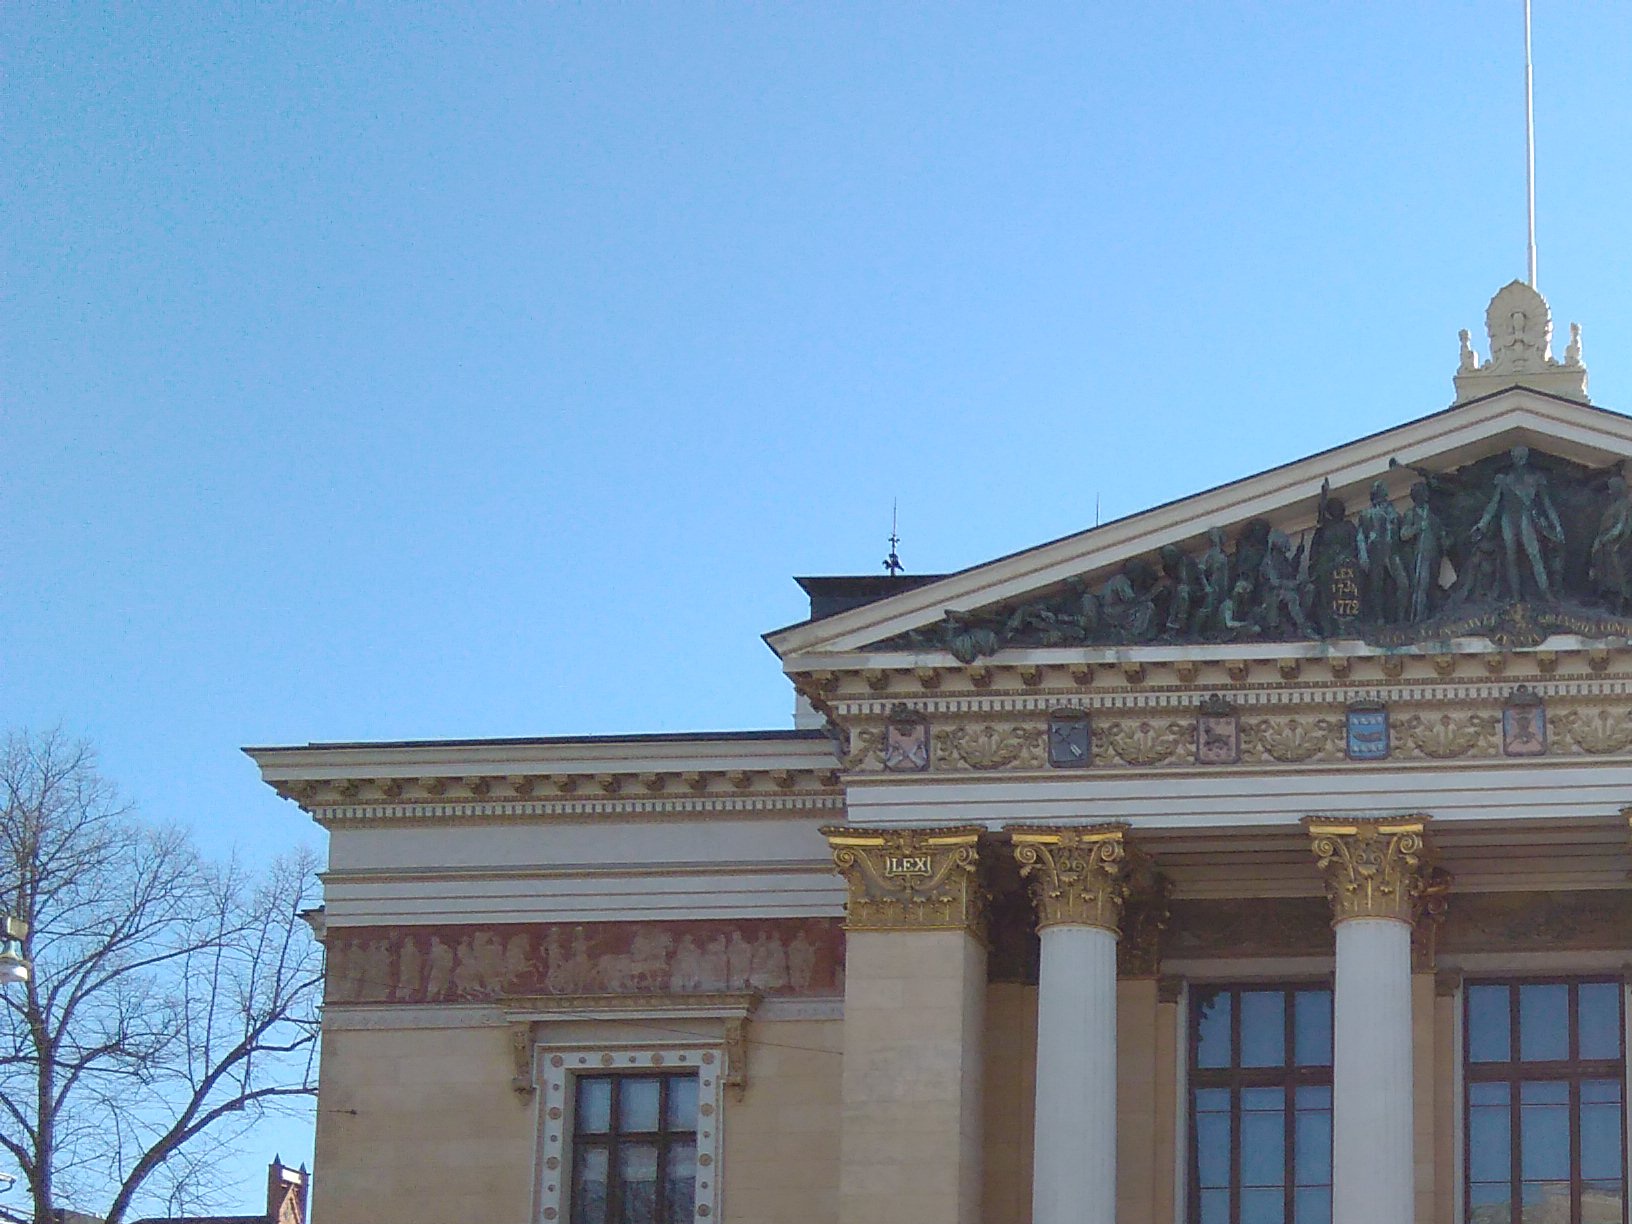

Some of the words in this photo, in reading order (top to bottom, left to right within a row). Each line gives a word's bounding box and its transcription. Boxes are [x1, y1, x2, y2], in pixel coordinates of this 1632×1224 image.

[1332, 568, 1355, 579] LEX
[1332, 600, 1360, 615] 1772
[890, 857, 926, 871] LEX
